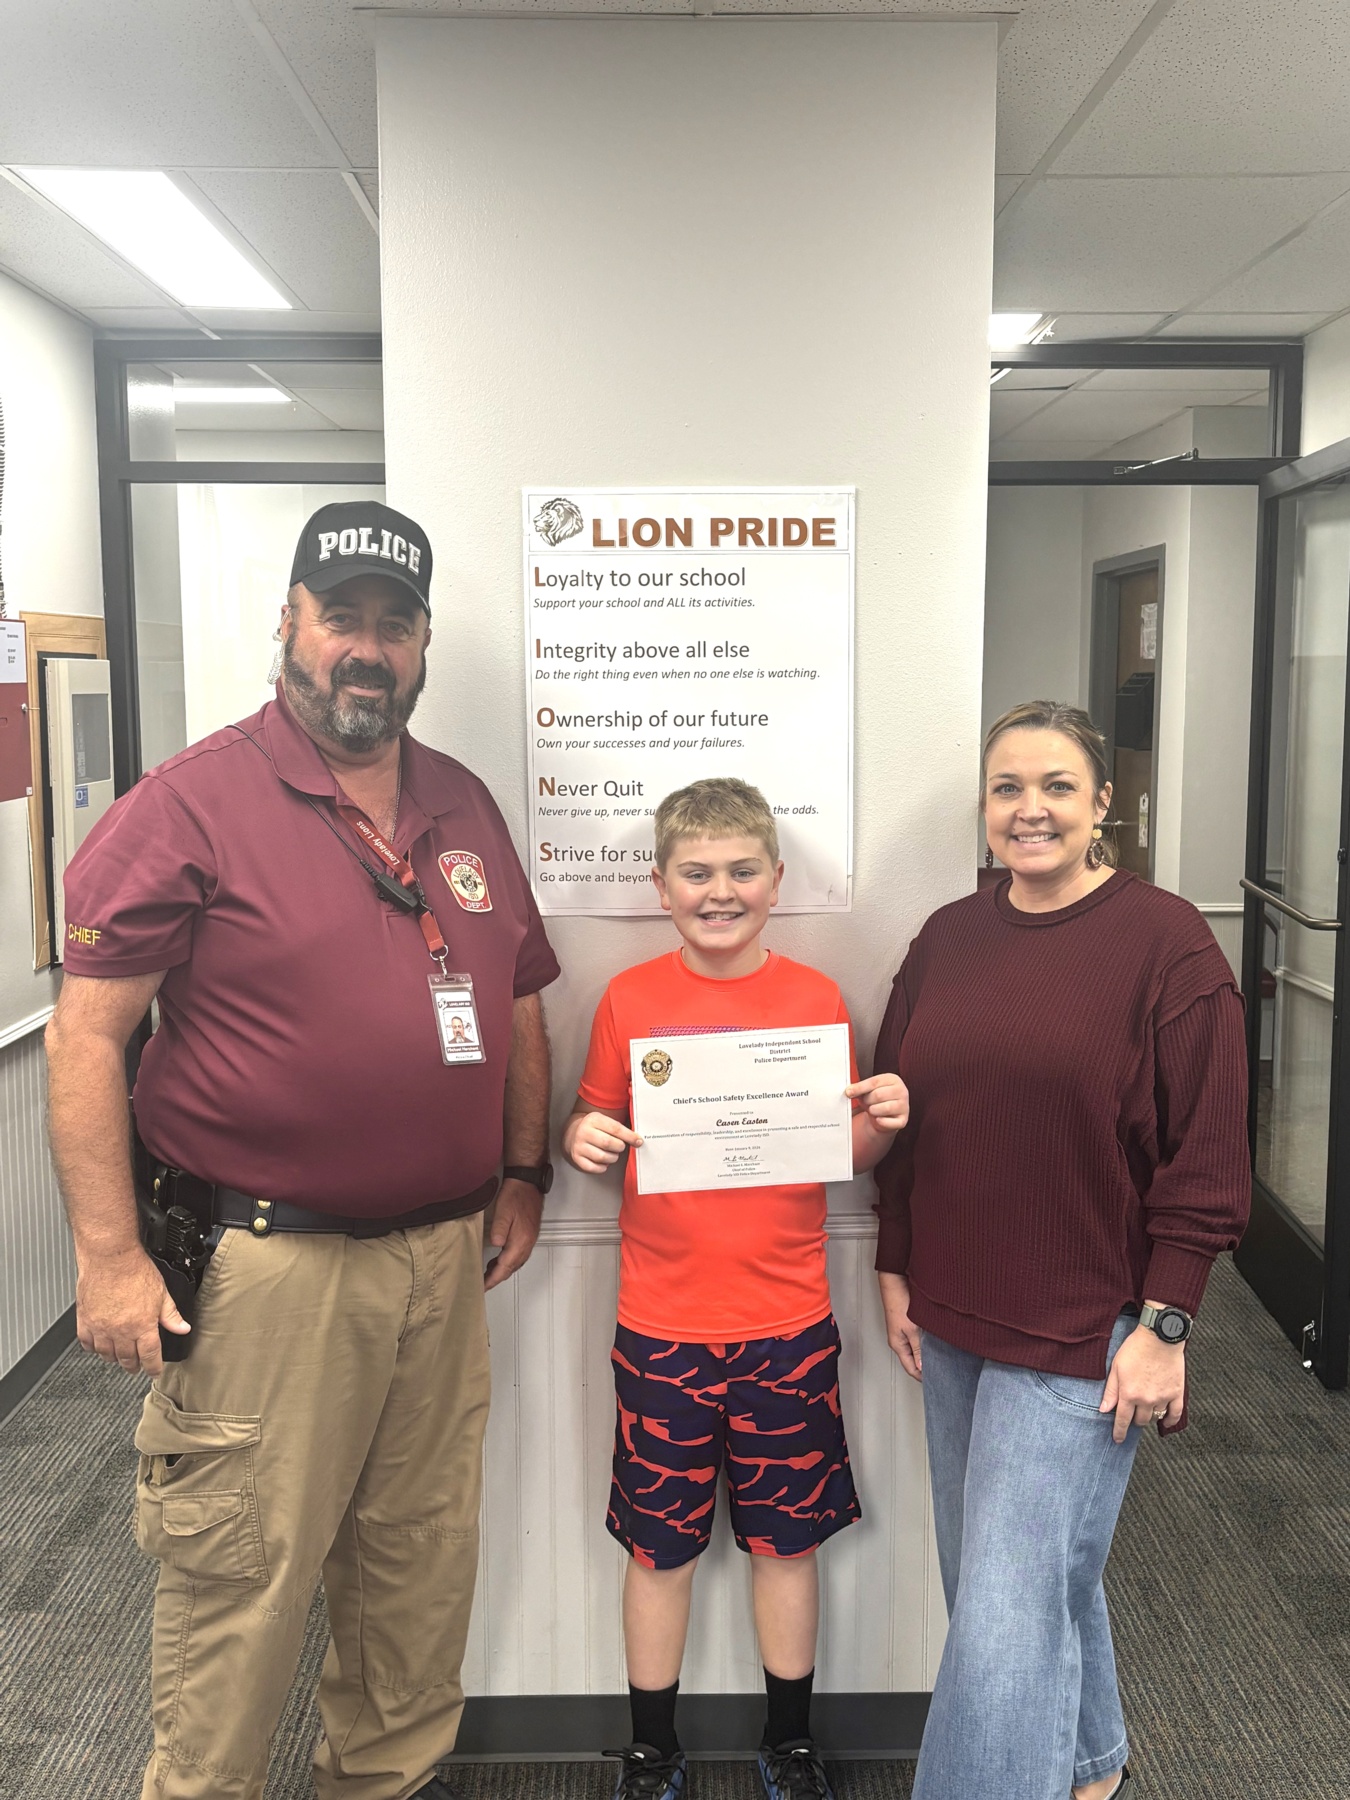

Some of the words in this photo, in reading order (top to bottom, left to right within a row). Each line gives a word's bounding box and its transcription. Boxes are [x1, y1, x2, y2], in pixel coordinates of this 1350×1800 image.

[592, 517, 693, 548] LION
[710, 517, 837, 548] PRIDE
[318, 527, 421, 576] POLICE
[535, 567, 603, 591] Loyalty
[609, 570, 631, 587] to
[638, 573, 673, 587] our
[679, 567, 745, 587] school
[533, 598, 576, 610] Support
[579, 600, 603, 610] your
[606, 598, 641, 608] school
[643, 598, 664, 608] and
[667, 598, 686, 608] ALL
[689, 598, 701, 608] its
[704, 597, 755, 608] activities.
[536, 639, 617, 662] Integrity
[623, 641, 679, 658] above
[686, 641, 706, 658] all
[713, 641, 749, 658] else
[535, 670, 550, 680] Do
[553, 670, 570, 679] the
[573, 669, 599, 681] right
[602, 669, 630, 681] thing
[633, 671, 658, 679] even
[661, 669, 690, 679] when
[693, 671, 707, 679] no
[710, 671, 730, 679] one
[733, 668, 753, 679] else
[757, 668, 764, 679] is
[768, 668, 820, 681] watching.
[536, 707, 642, 731] Ownership
[649, 710, 668, 727] of
[673, 714, 705, 727] our
[711, 710, 769, 727] future
[536, 738, 562, 749] Own
[565, 740, 590, 750] your
[593, 740, 646, 749] successes
[649, 738, 670, 748] and
[673, 740, 698, 750] your
[700, 737, 745, 750] failures.
[539, 777, 598, 797] Never
[603, 780, 644, 799] Quit
[538, 807, 568, 817] Never
[570, 806, 591, 819] give
[594, 808, 610, 819] up,
[613, 808, 642, 816] never
[773, 805, 790, 815] the
[792, 804, 819, 815] odds.
[356, 821, 375, 839] Lions
[373, 838, 400, 866] Lovelady
[539, 842, 595, 862] Strive
[599, 845, 628, 862] for
[443, 854, 479, 868] POLICE
[540, 872, 555, 883] Go
[558, 872, 591, 883] above
[594, 872, 614, 882] and
[618, 872, 652, 885] beyon
[68, 923, 102, 946] CHIEF
[802, 1037, 821, 1045] School
[772, 1055, 807, 1063] Department
[672, 1096, 697, 1105] Chief's
[698, 1095, 722, 1103] School
[723, 1093, 745, 1102] Safety
[746, 1091, 784, 1100] Excellence
[785, 1090, 809, 1098] Award
[716, 1118, 740, 1127] Casen
[741, 1117, 769, 1126] Easton
